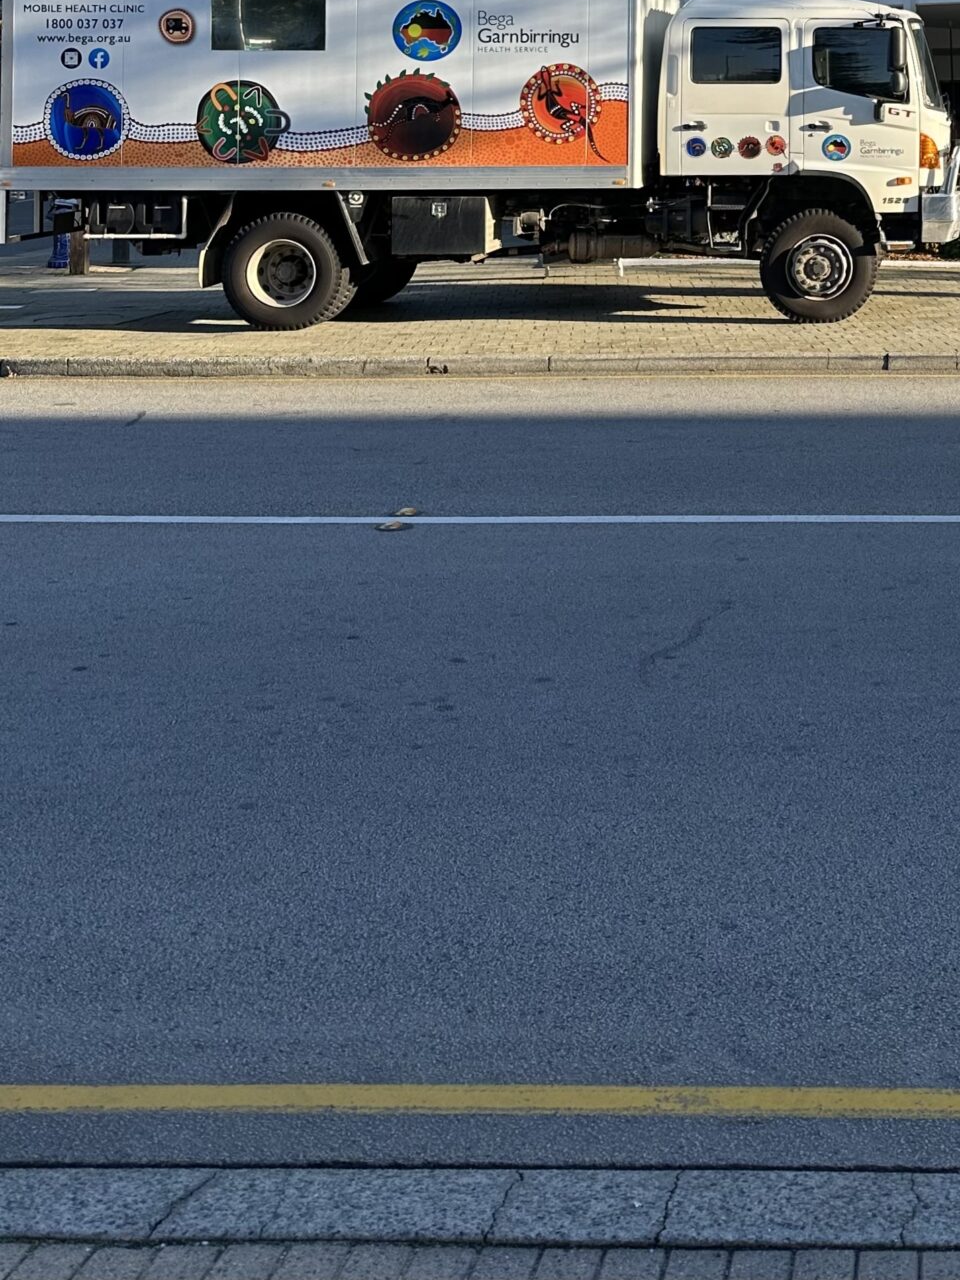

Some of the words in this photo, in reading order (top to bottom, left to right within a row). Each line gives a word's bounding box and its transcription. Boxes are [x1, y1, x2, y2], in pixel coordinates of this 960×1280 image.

[23, 4, 63, 13] MOBILE
[65, 4, 107, 13] HEALTH
[110, 4, 145, 13] CLINIC
[46, 18, 73, 29] 1800
[77, 18, 99, 29] 037
[102, 18, 124, 29] 037
[478, 10, 514, 29] Bega
[37, 33, 131, 45] www.bega.org.au
[477, 28, 580, 48] Garnbirringu
[888, 107, 916, 118] GT
